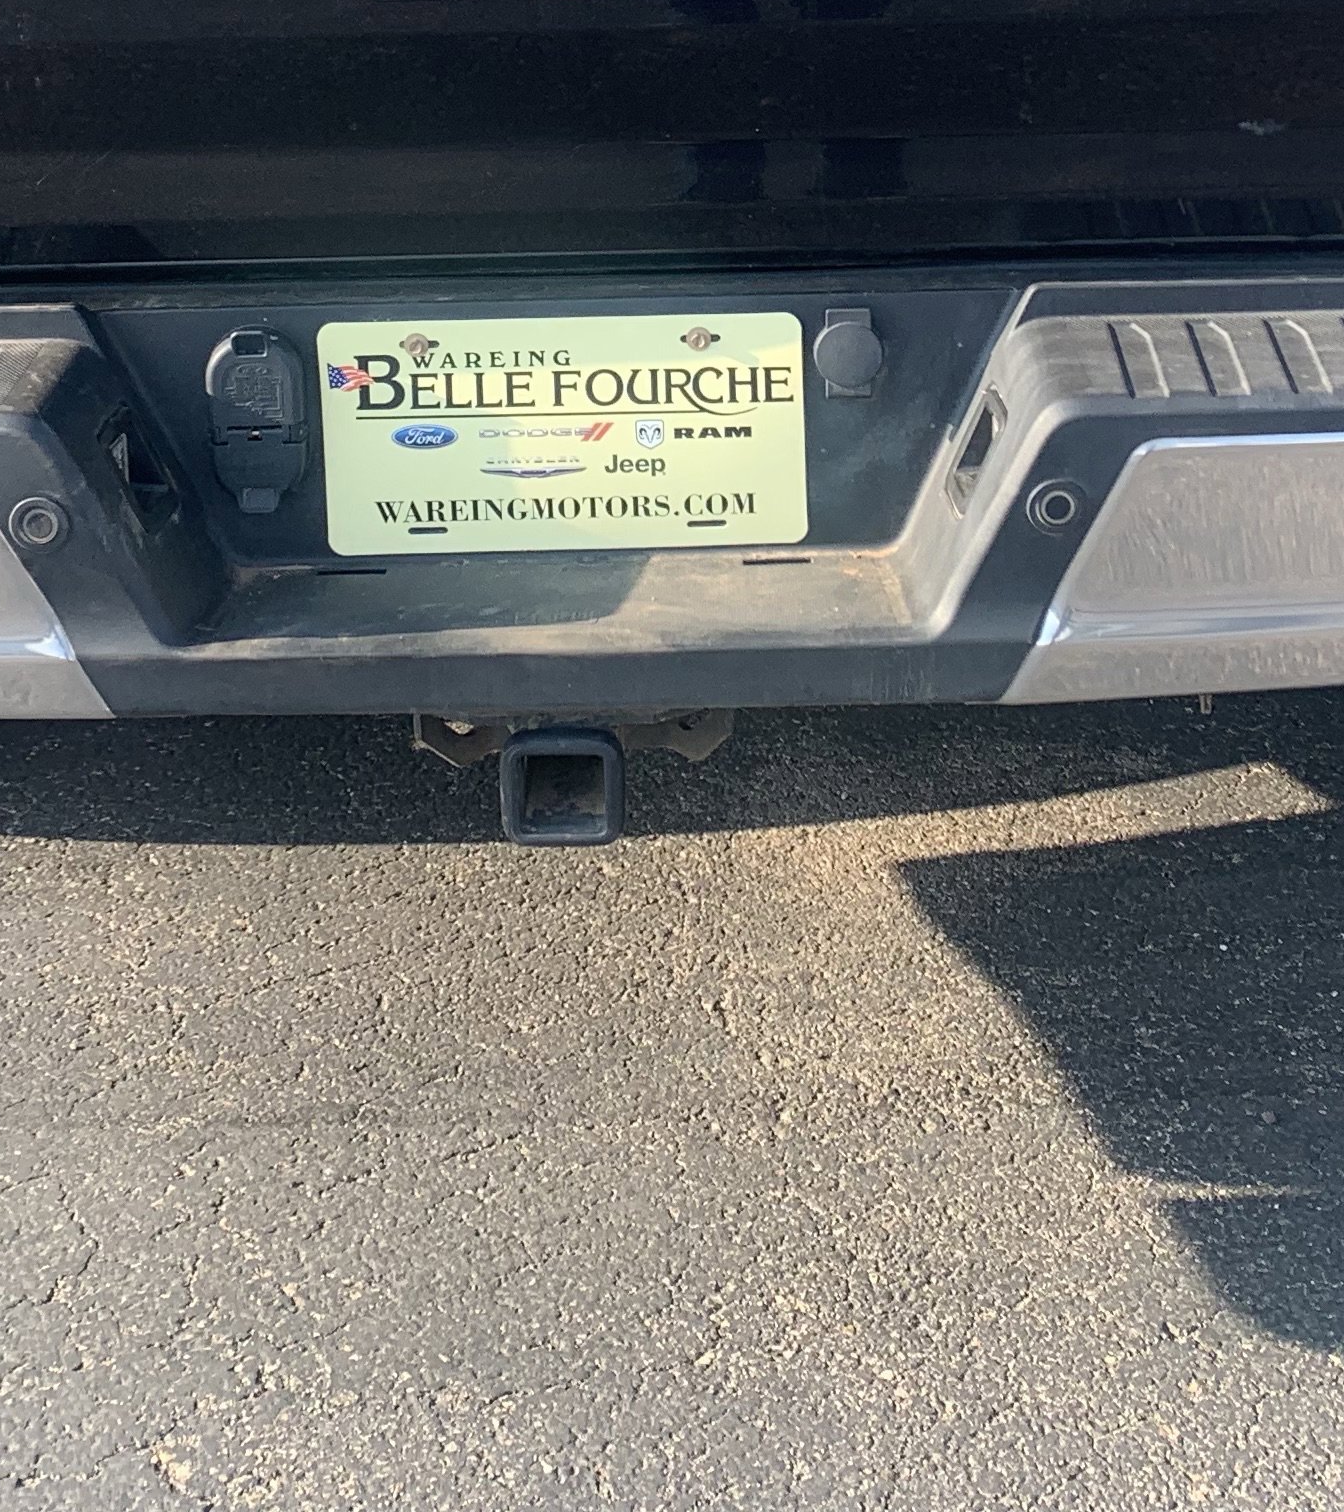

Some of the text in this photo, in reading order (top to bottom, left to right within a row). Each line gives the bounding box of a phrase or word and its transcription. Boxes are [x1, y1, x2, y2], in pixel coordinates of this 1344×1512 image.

[411, 349, 573, 370] WAREING
[354, 354, 795, 414] BELLE FOURCHE
[404, 427, 446, 445] Ford
[479, 427, 595, 438] DODGE
[673, 426, 753, 439] RAM
[604, 454, 666, 476] Jeep
[375, 492, 757, 525] WAREINGMOTORS.COM
